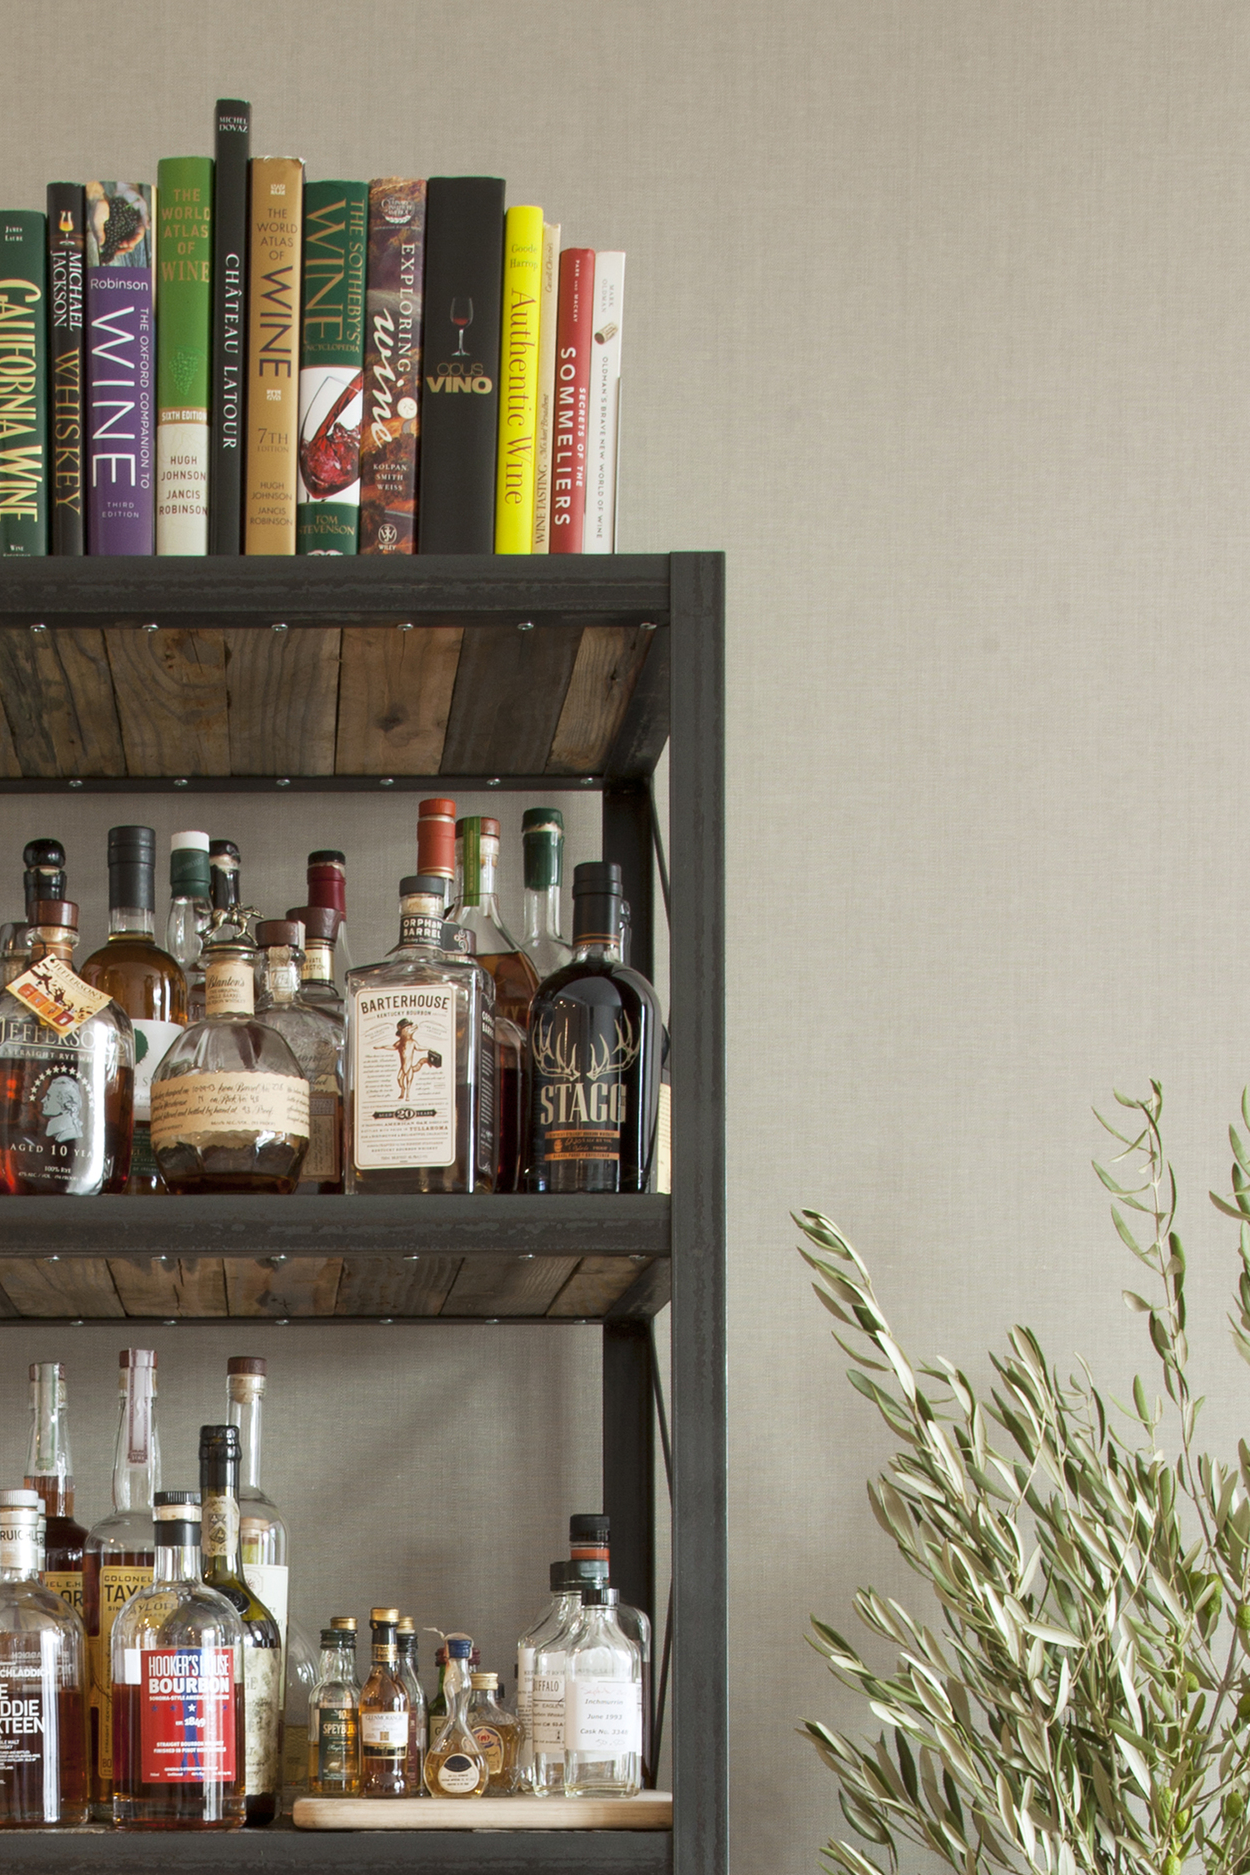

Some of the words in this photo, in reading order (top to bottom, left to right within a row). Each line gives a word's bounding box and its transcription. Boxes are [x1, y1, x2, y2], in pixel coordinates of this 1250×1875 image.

[173, 189, 202, 202] THE
[161, 207, 210, 221] WORLD
[267, 208, 288, 219] THE
[349, 199, 365, 236] THE
[163, 225, 210, 239] ATLAS
[256, 222, 299, 234] WORLD
[177, 241, 196, 255] OF
[260, 236, 294, 248] ATLAS
[268, 250, 285, 260] OF
[161, 261, 210, 283] WINE
[303, 198, 347, 345] WINE
[51, 250, 68, 328] JACKSON
[69, 251, 83, 332] MICHAEL
[90, 277, 149, 292] Robinson
[346, 241, 364, 346] SOTHEBY'S
[224, 253, 243, 355] CHÂTEAU
[397, 243, 416, 373] EXPLORING
[139, 308, 149, 331] THE
[259, 265, 294, 379] WINE
[139, 336, 150, 388] OXFORD
[507, 288, 537, 428] Authentic
[370, 308, 405, 449] wine
[426, 376, 494, 395] VINO
[91, 306, 136, 487] WINE
[223, 366, 240, 450] LATOUR
[161, 410, 181, 422] SIXTH
[55, 347, 81, 516] WHISKEY
[139, 392, 151, 468] COMPANION
[555, 346, 577, 526] SOMMELIERS
[170, 456, 198, 466] HUGH
[160, 470, 207, 482] JOHNSON
[376, 473, 404, 481] SMITH
[505, 434, 534, 506] Wine
[140, 474, 151, 490] TO
[260, 481, 285, 491] HUGH
[166, 490, 201, 500] JANCIS
[251, 492, 293, 501] JOHNSON
[158, 504, 208, 517] ROBINSON
[257, 507, 287, 516] JANCIS
[249, 517, 293, 527] ROBINSON
[314, 515, 338, 525] TOM
[402, 927, 442, 939] BARREL
[207, 975, 246, 991] Blanton's
[360, 993, 451, 1014] BARTERHOUSE
[376, 1010, 405, 1020] KENTUCKY
[406, 1009, 432, 1018] BOURBON
[58, 1052, 76, 1063] RYE
[540, 1081, 627, 1126] STAGG
[397, 1108, 415, 1120] 20
[10, 1143, 45, 1153] AGED
[51, 1145, 69, 1157] 10
[104, 1575, 155, 1583] COLONEL
[149, 1655, 200, 1678] HOOKER'S
[148, 1677, 231, 1694] BOURBON
[184, 1716, 206, 1728] 1849
[587, 1713, 603, 1721] June
[579, 1727, 596, 1736] Cask
